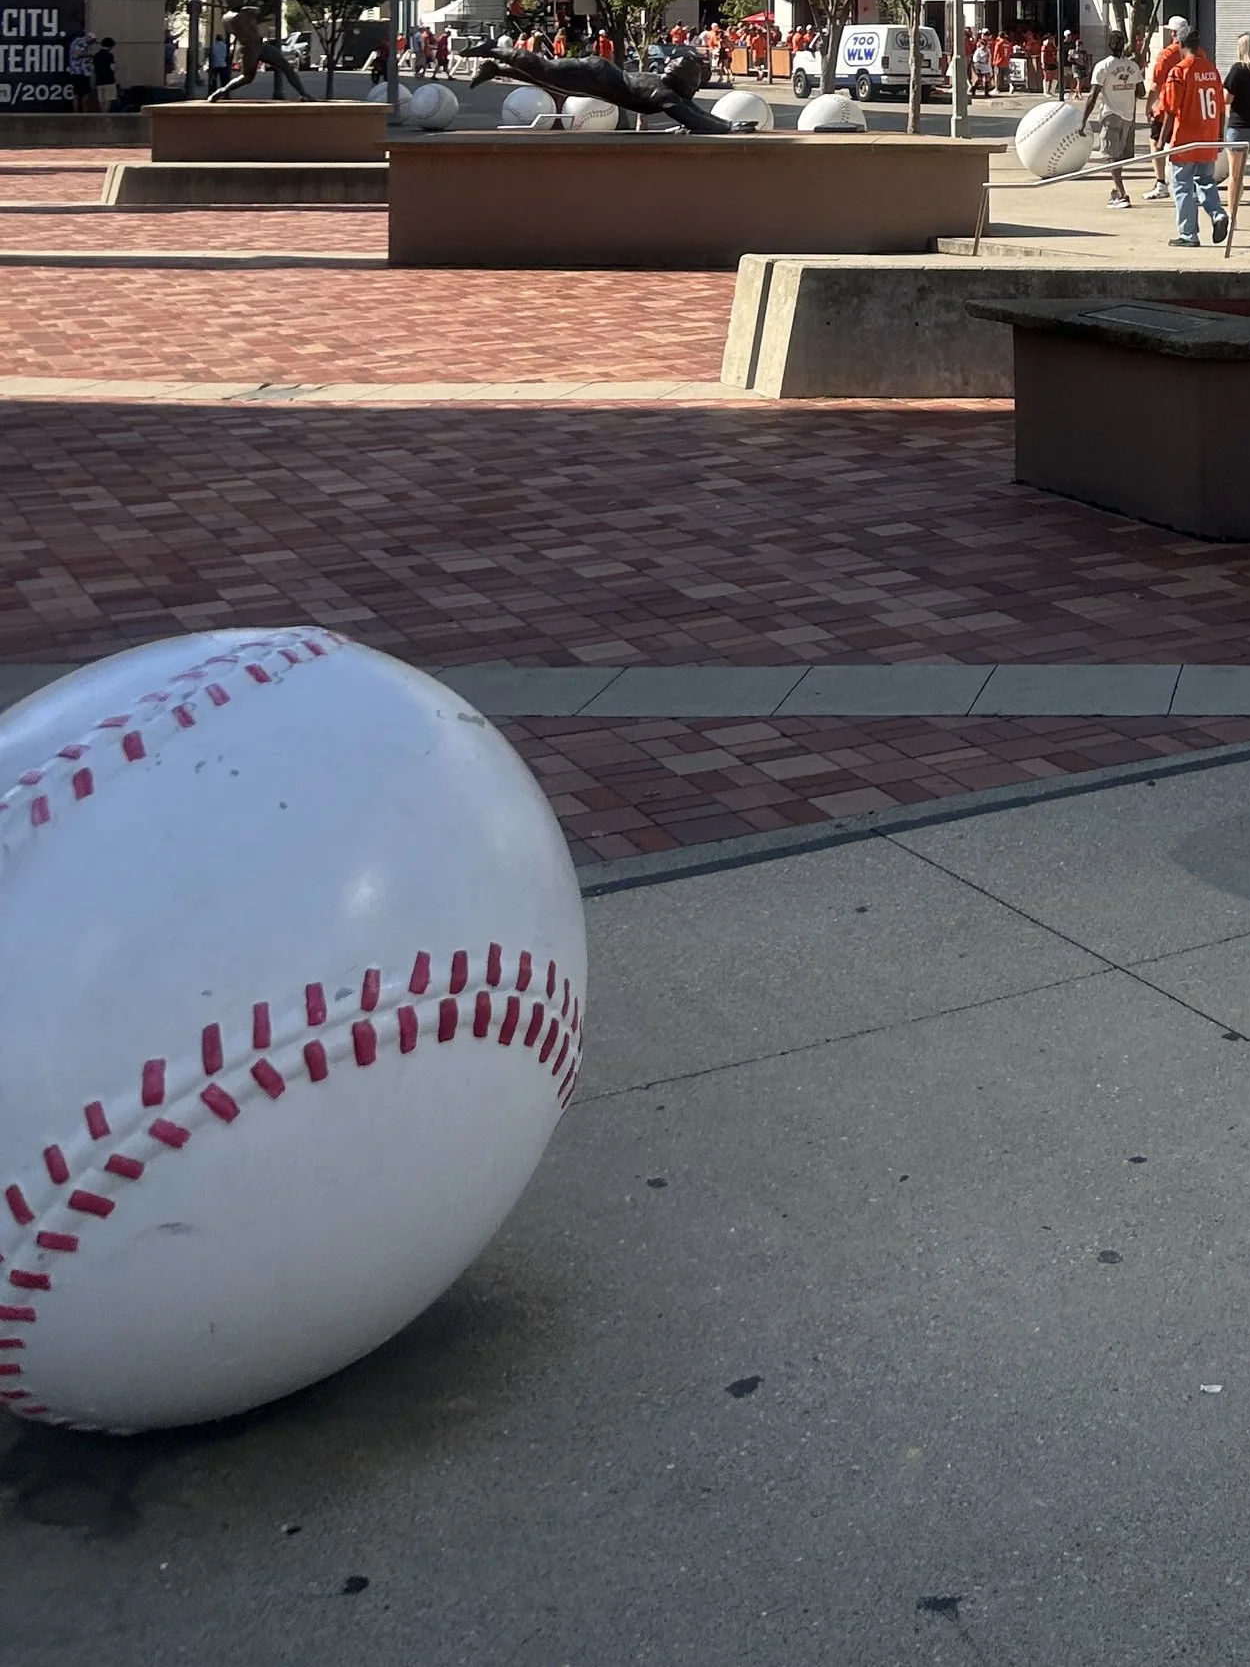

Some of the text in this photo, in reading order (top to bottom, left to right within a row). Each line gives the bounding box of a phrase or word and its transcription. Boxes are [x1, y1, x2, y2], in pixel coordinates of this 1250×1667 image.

[2, 8, 67, 37] CITY.
[852, 36, 875, 46] 700
[847, 48, 876, 61] WLW
[1197, 87, 1217, 121] 16
